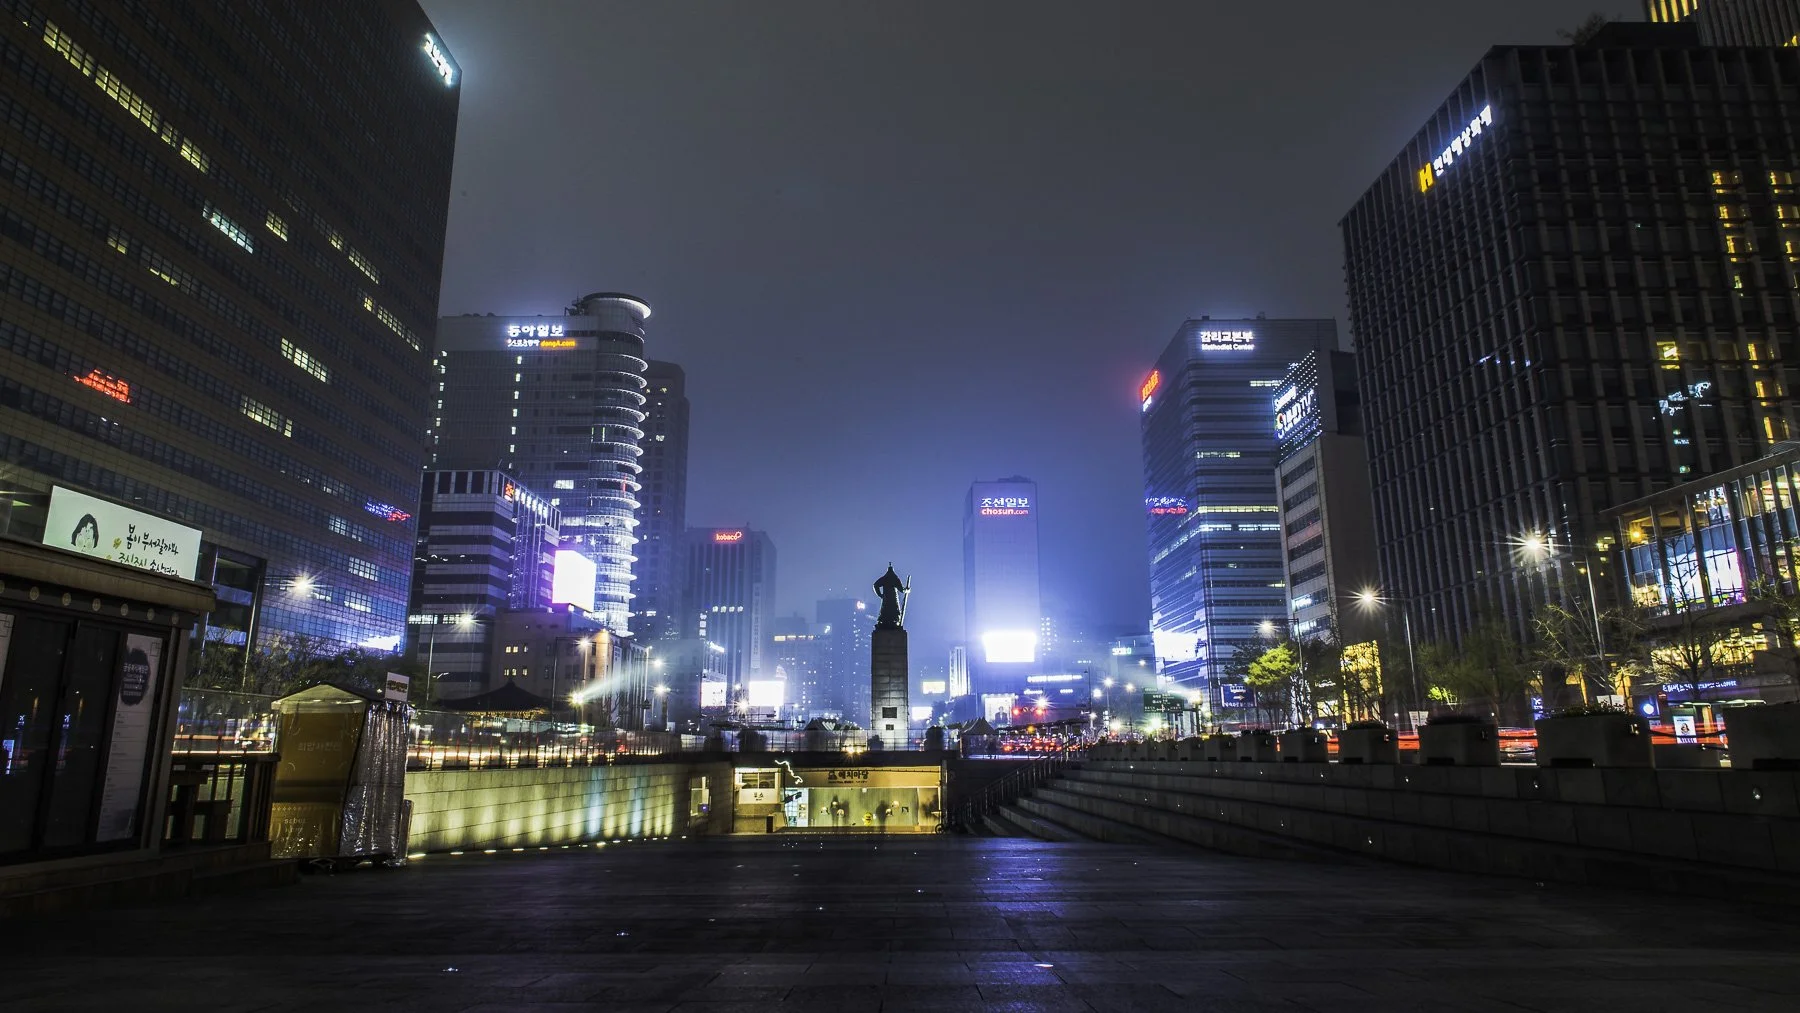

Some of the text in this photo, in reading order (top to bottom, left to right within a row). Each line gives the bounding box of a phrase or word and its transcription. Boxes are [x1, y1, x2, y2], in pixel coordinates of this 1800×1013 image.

[507, 325, 565, 338] 동아일보
[1200, 331, 1254, 343] 감리교본부
[980, 497, 1030, 508] 조선일보
[981, 507, 1029, 515] chosun.com
[127, 523, 141, 550] 봄이
[716, 531, 742, 541] kobaco
